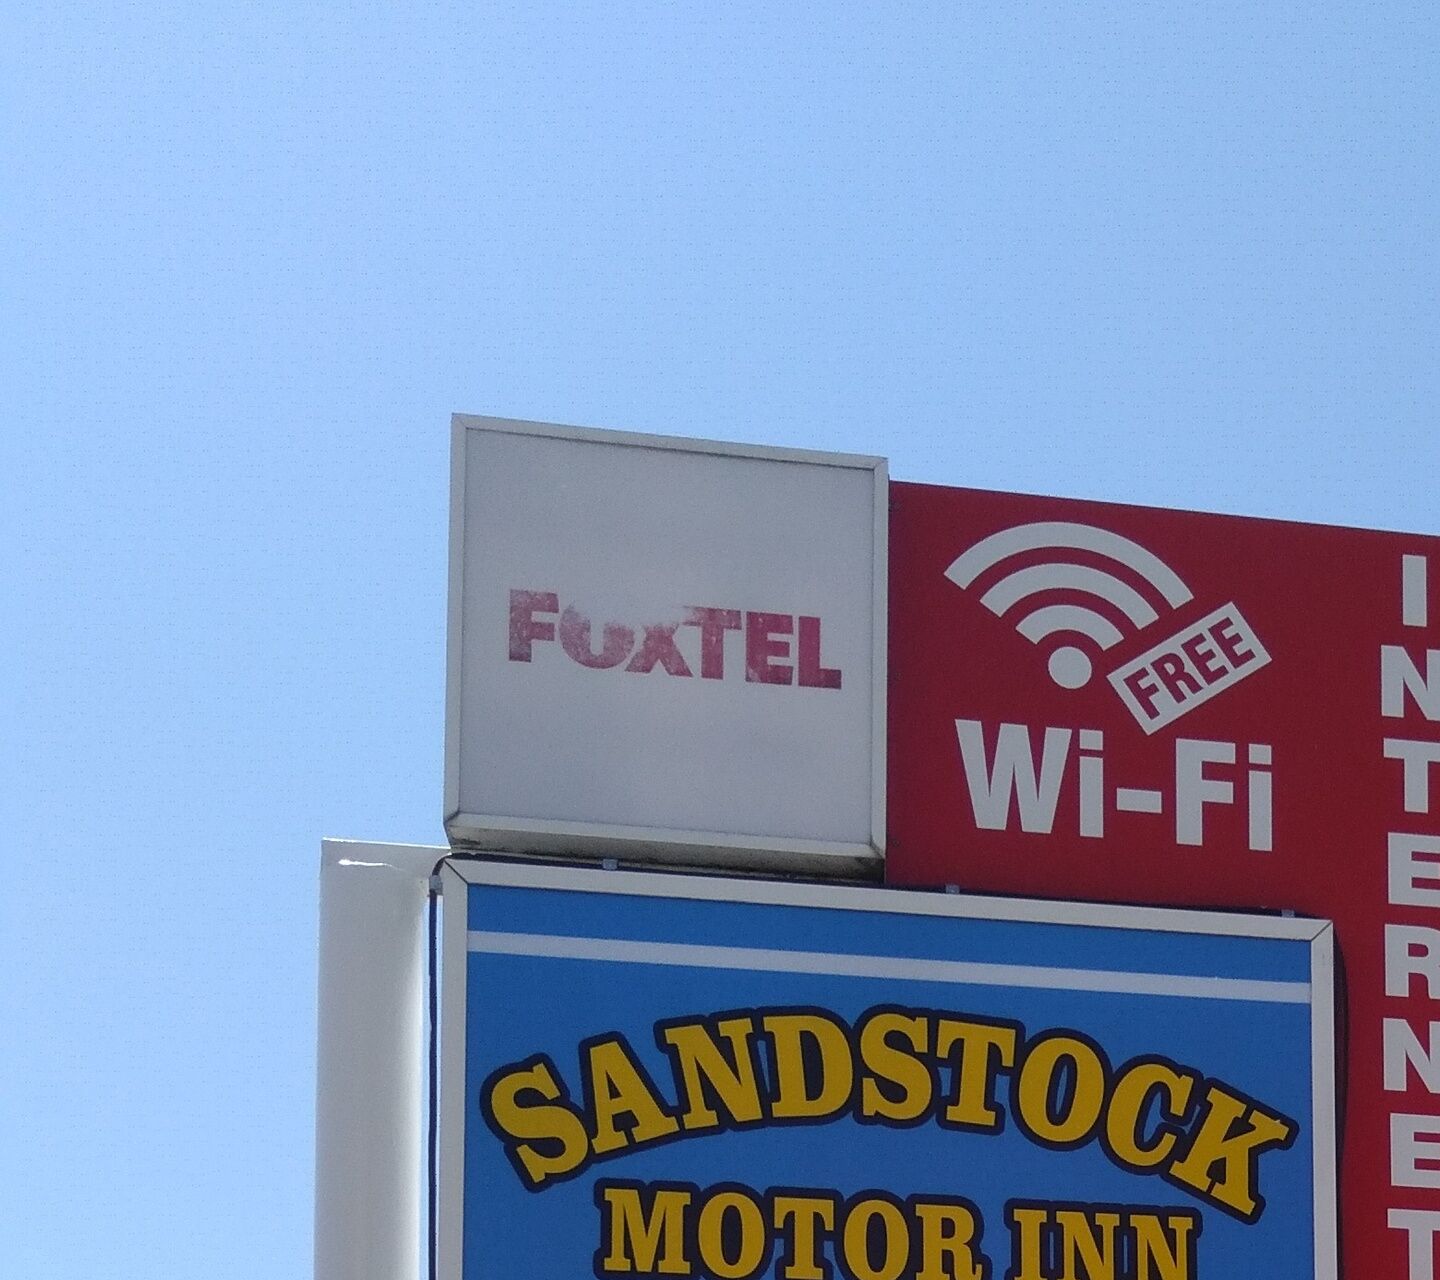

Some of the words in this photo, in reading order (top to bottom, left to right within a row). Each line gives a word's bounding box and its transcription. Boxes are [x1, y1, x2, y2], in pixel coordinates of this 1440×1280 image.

[508, 588, 842, 690] FOXTEL
[1123, 616, 1256, 710] FREE
[954, 717, 1274, 852] Wi-Fi
[486, 1008, 1294, 1220] SANDSTOCK
